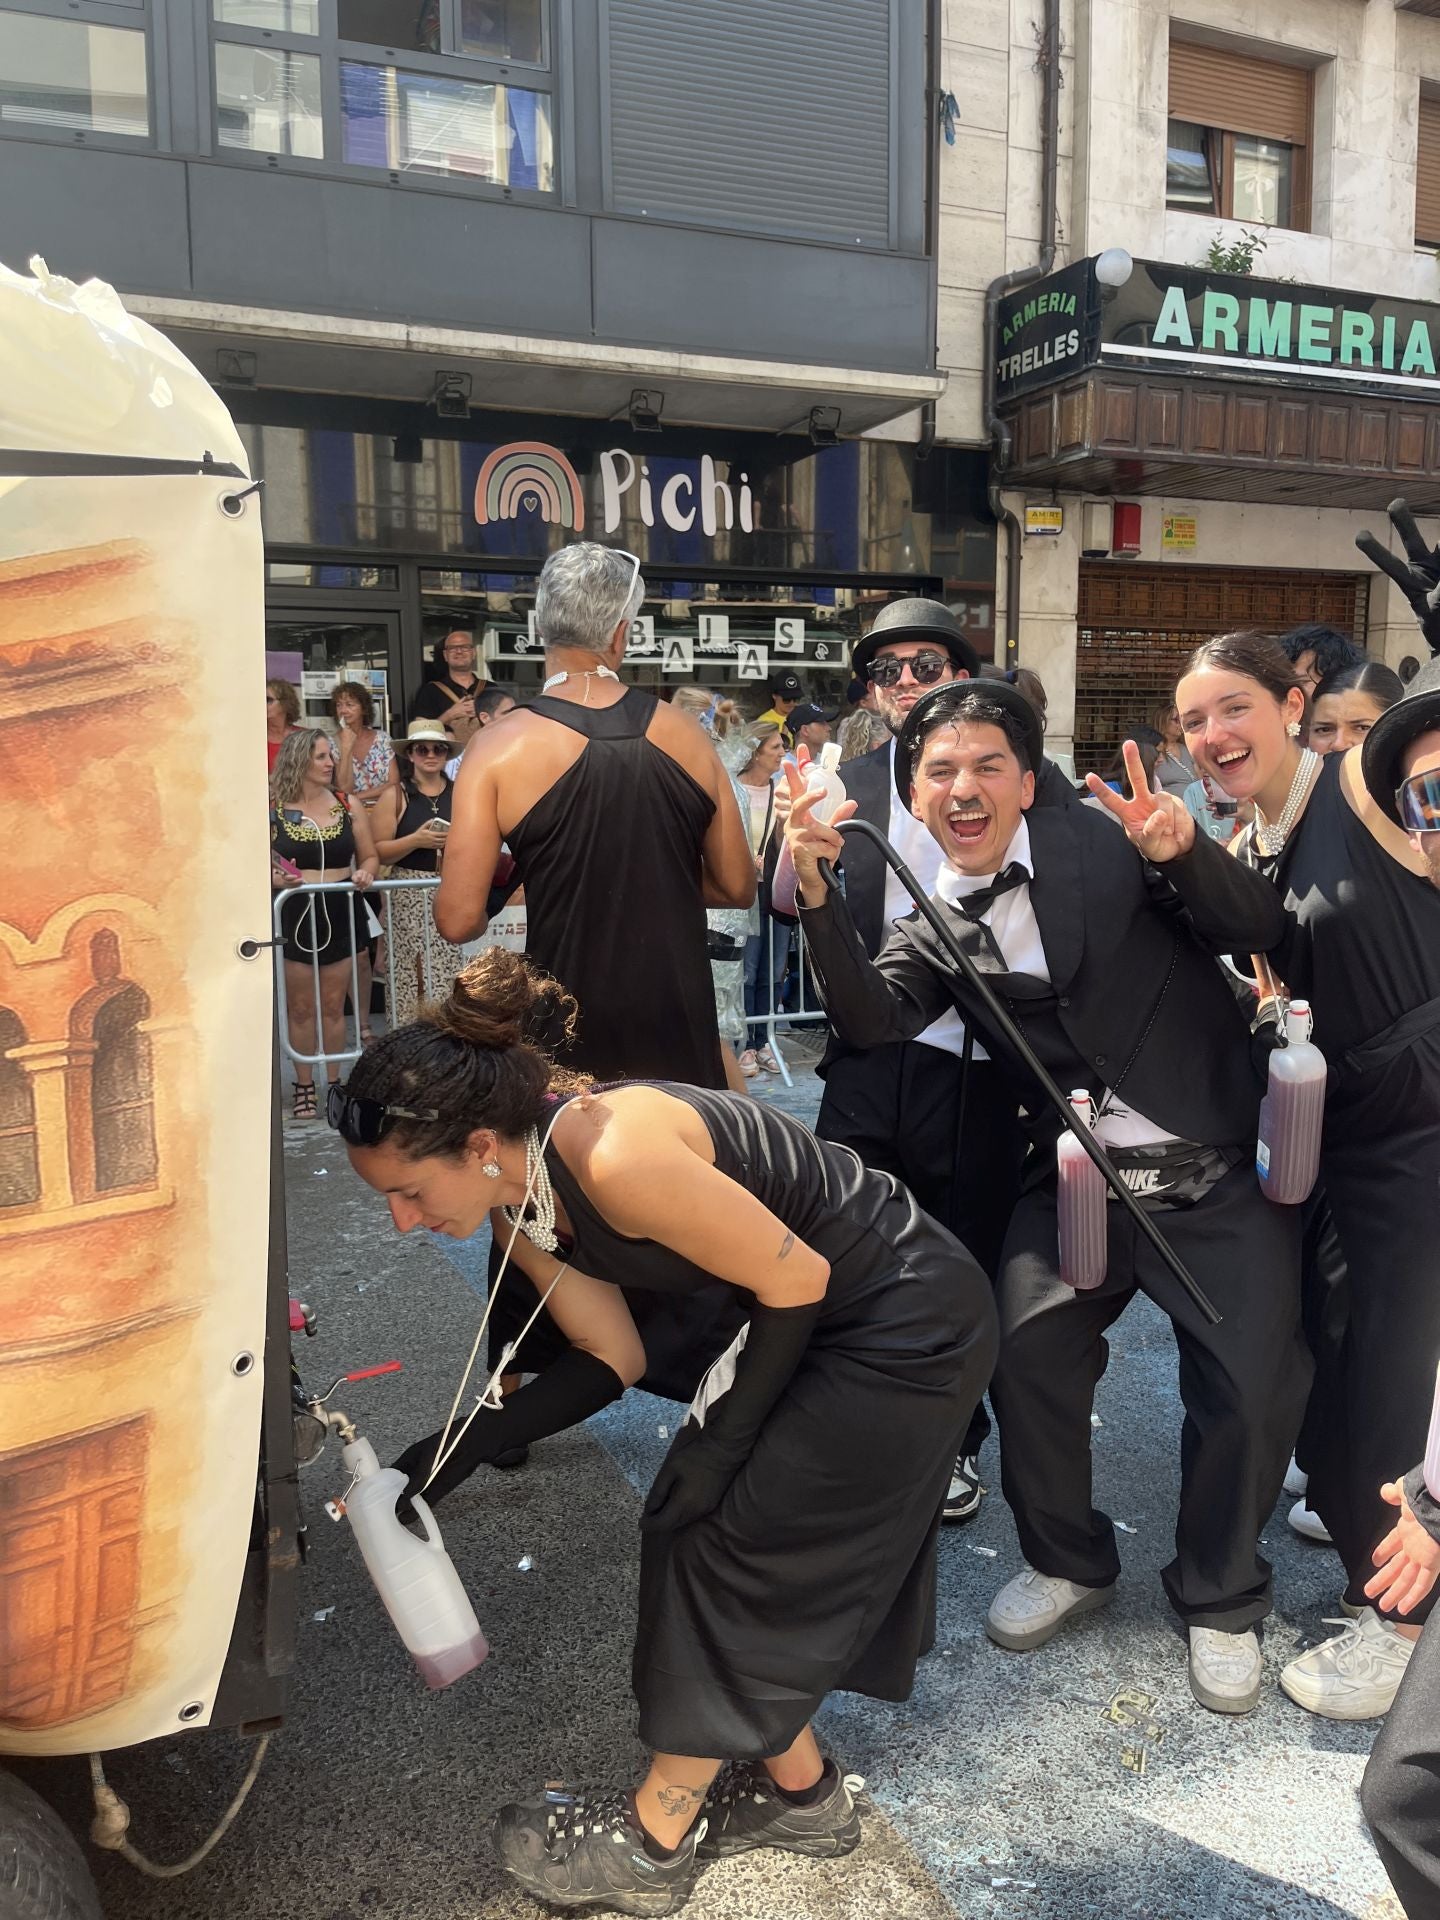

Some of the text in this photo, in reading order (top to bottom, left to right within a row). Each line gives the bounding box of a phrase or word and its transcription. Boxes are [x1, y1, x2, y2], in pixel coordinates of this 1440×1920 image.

[1003, 292, 1076, 345] ARMERIA
[1152, 286, 1436, 374] ARMERIA
[600, 448, 753, 536] Pichi
[1119, 1169, 1161, 1190] NIKE
